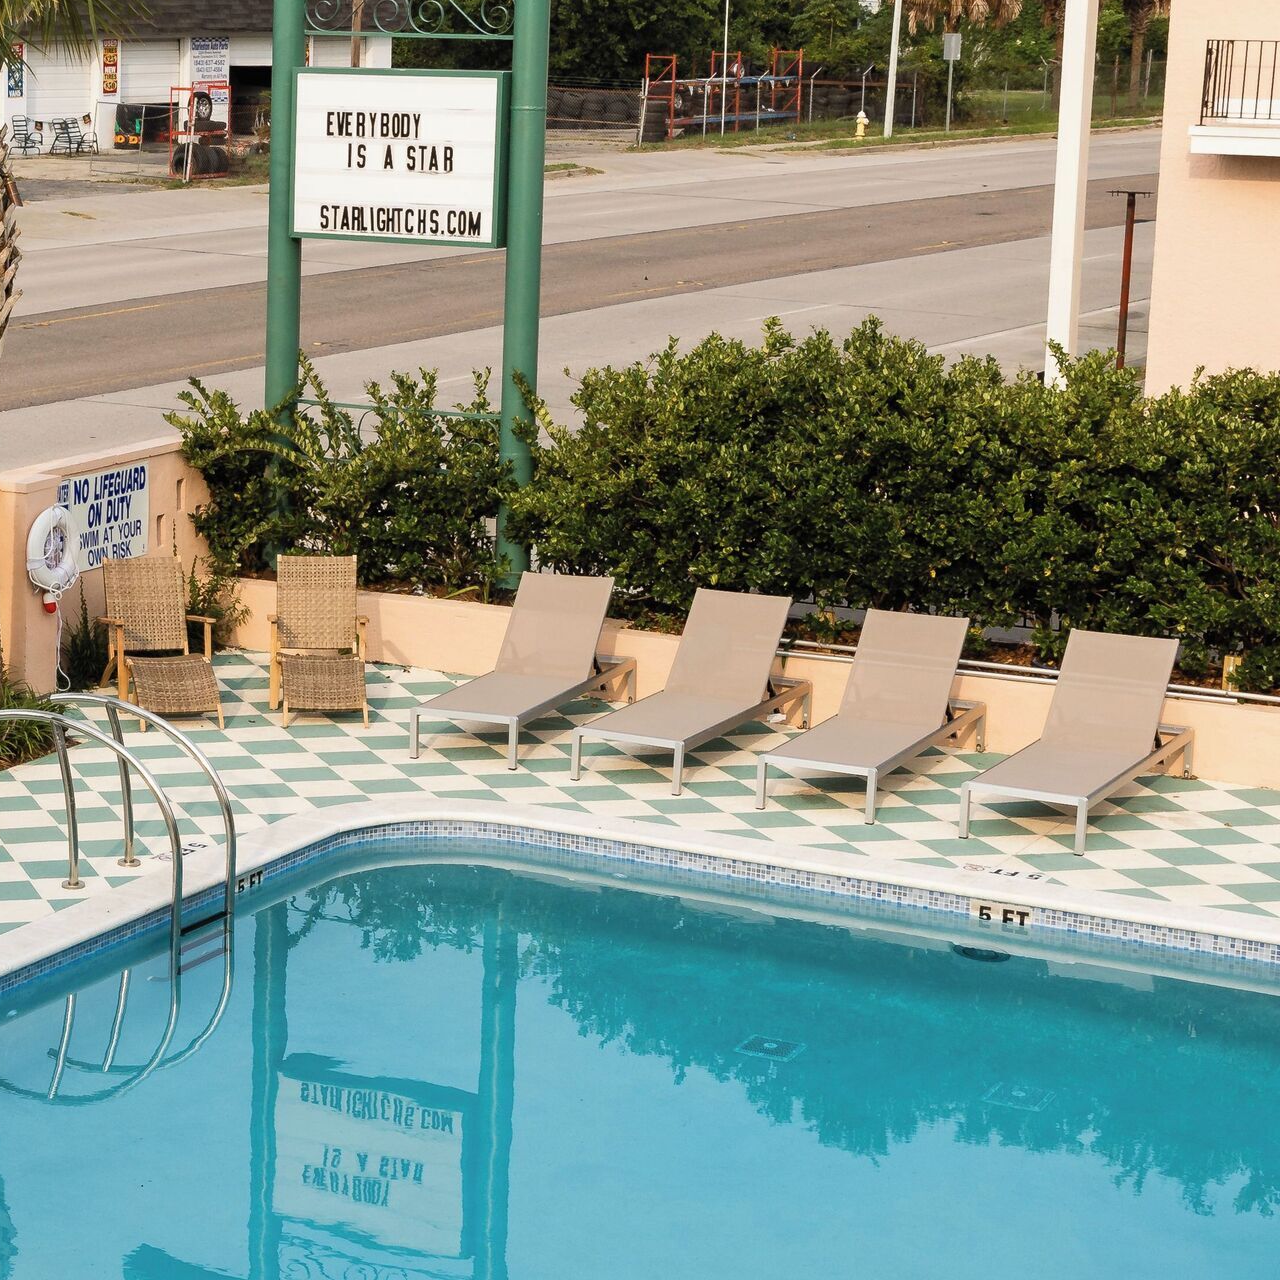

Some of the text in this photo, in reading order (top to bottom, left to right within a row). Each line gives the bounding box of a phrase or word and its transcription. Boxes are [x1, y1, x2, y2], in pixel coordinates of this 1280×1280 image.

[326, 111, 421, 139] EVERYBODY
[347, 143, 454, 171] IS A STAR
[320, 205, 482, 236] STARLIGHTCHS.COM
[73, 466, 146, 506] NO LIFEGUARD
[87, 495, 132, 528] ON DUTY
[103, 526, 114, 544] AT
[118, 519, 142, 540] YOUR
[88, 540, 132, 567] OWN RISK
[978, 905, 1029, 926] 5 FT
